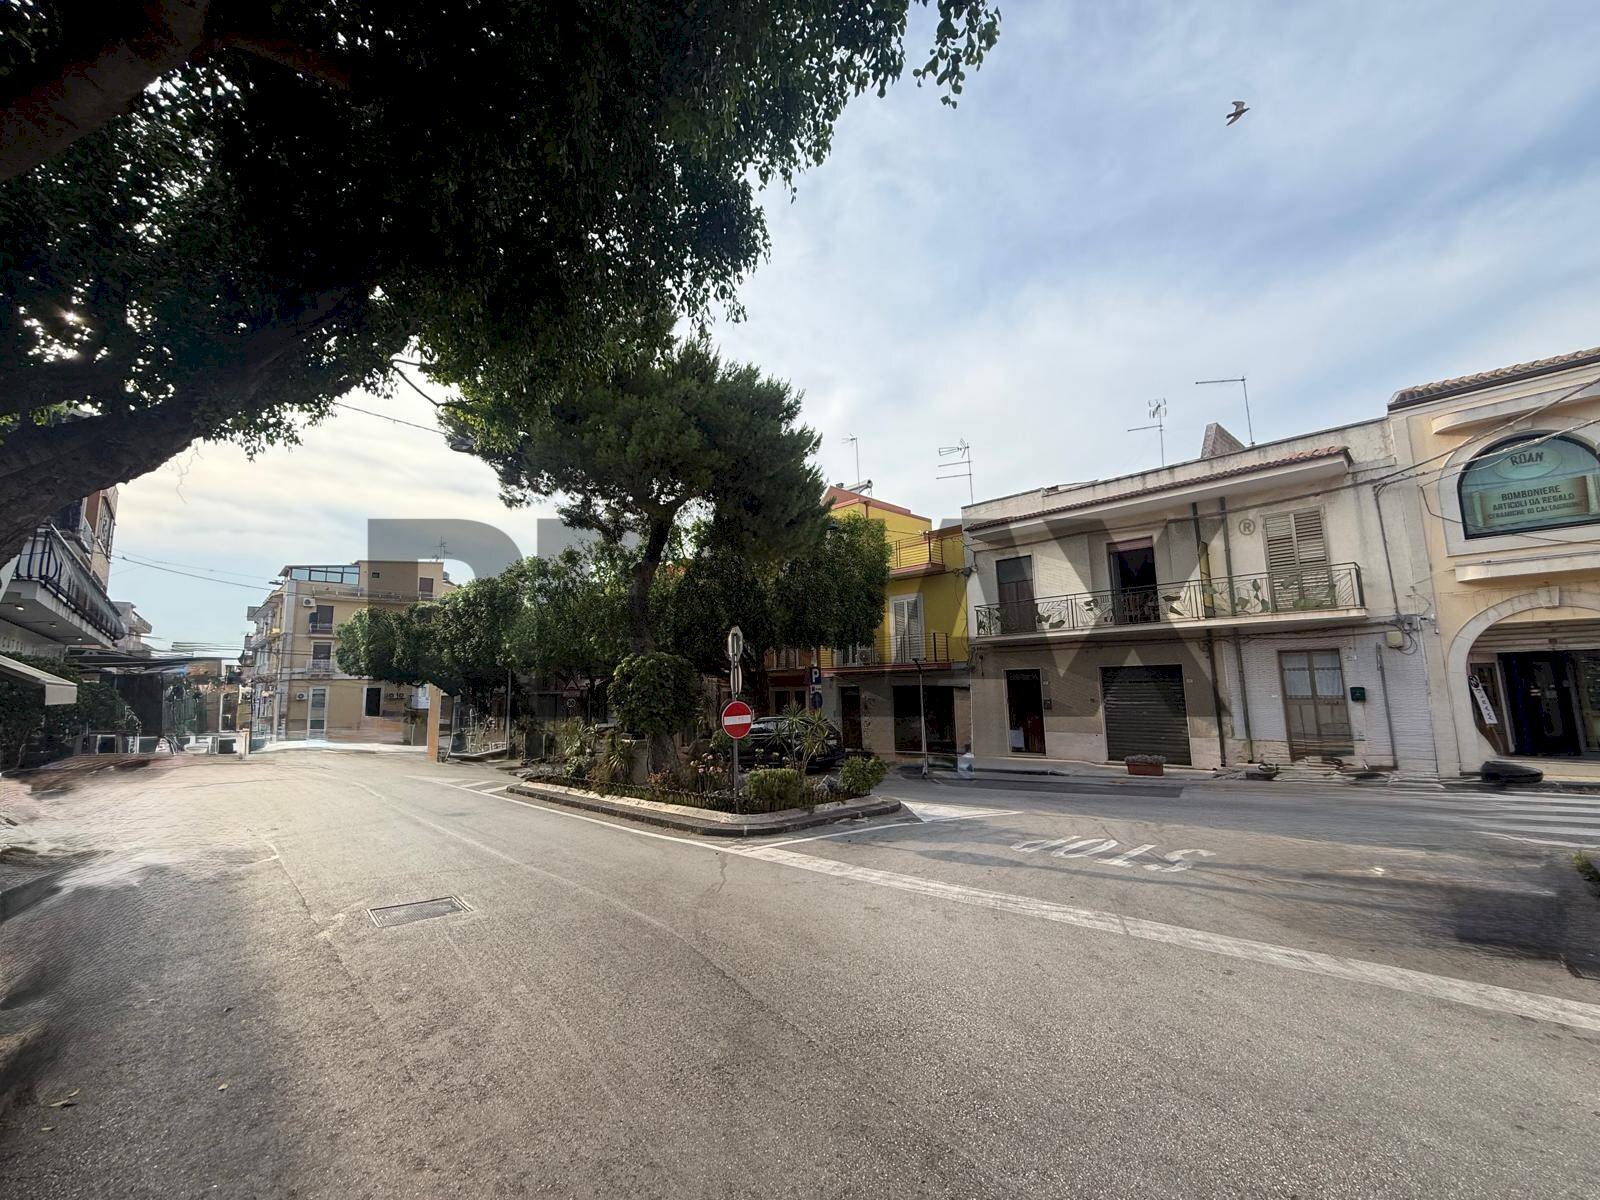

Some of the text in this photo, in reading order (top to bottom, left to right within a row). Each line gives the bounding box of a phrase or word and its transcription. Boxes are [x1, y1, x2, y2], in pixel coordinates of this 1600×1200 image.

[1501, 484, 1561, 501] BOMBONIERE
[1493, 493, 1575, 511] ARTICOLI DA REGALO
[812, 668, 819, 682] P
[1010, 835, 1216, 873] STOP
